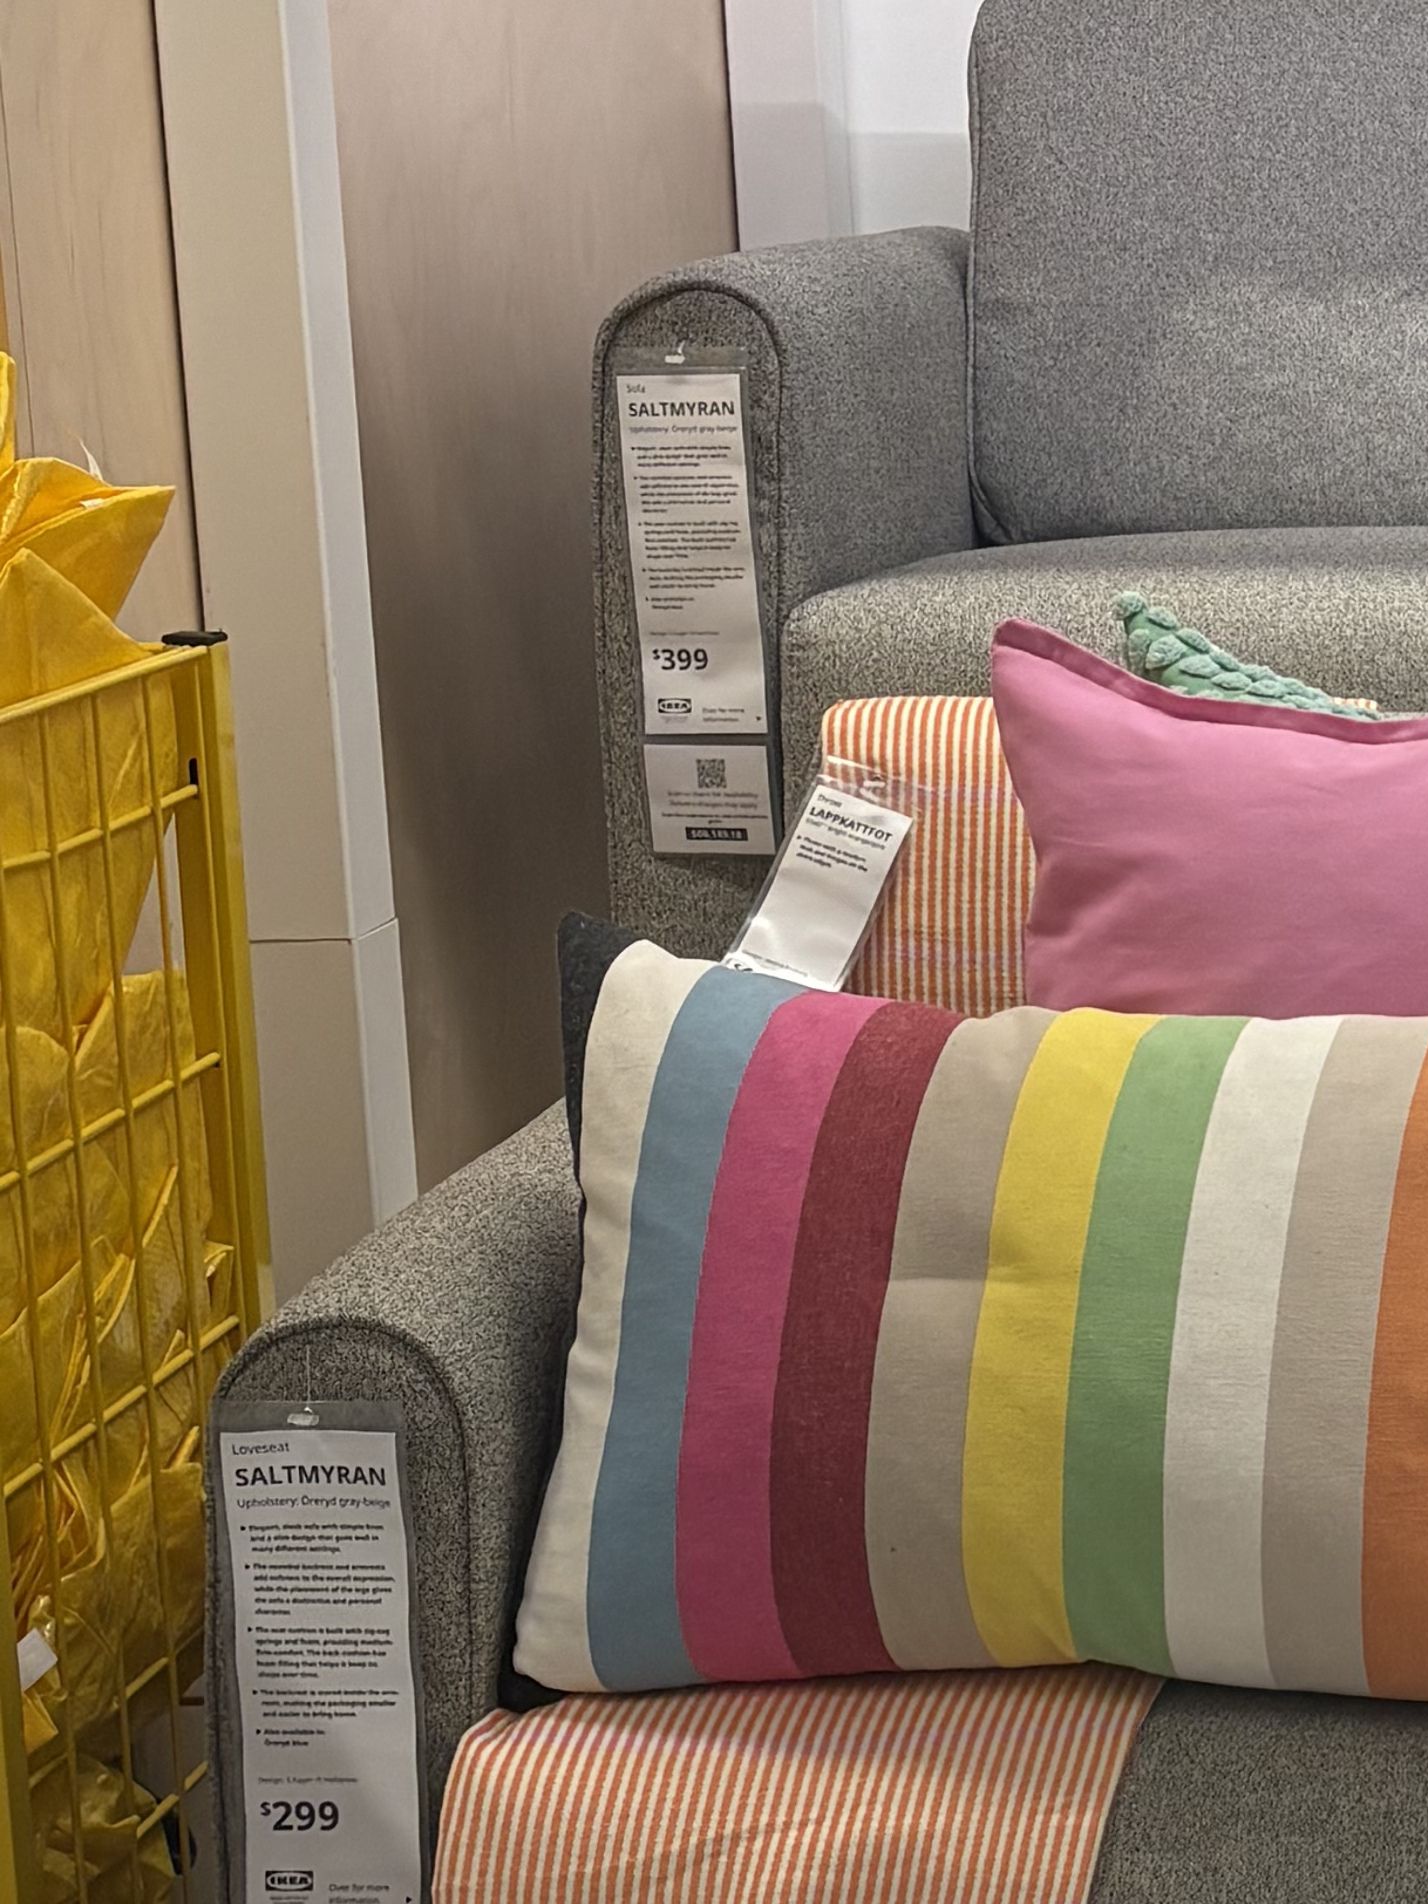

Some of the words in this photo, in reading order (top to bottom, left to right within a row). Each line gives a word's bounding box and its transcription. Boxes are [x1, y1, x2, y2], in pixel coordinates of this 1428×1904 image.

[628, 400, 735, 417] SALTMYRAN
[652, 648, 709, 670] $399
[809, 807, 893, 841] LAPPKATTFOT
[232, 1442, 290, 1456] Loveseat
[235, 1465, 386, 1487] SALTMYRAN
[260, 1801, 340, 1831] $299
